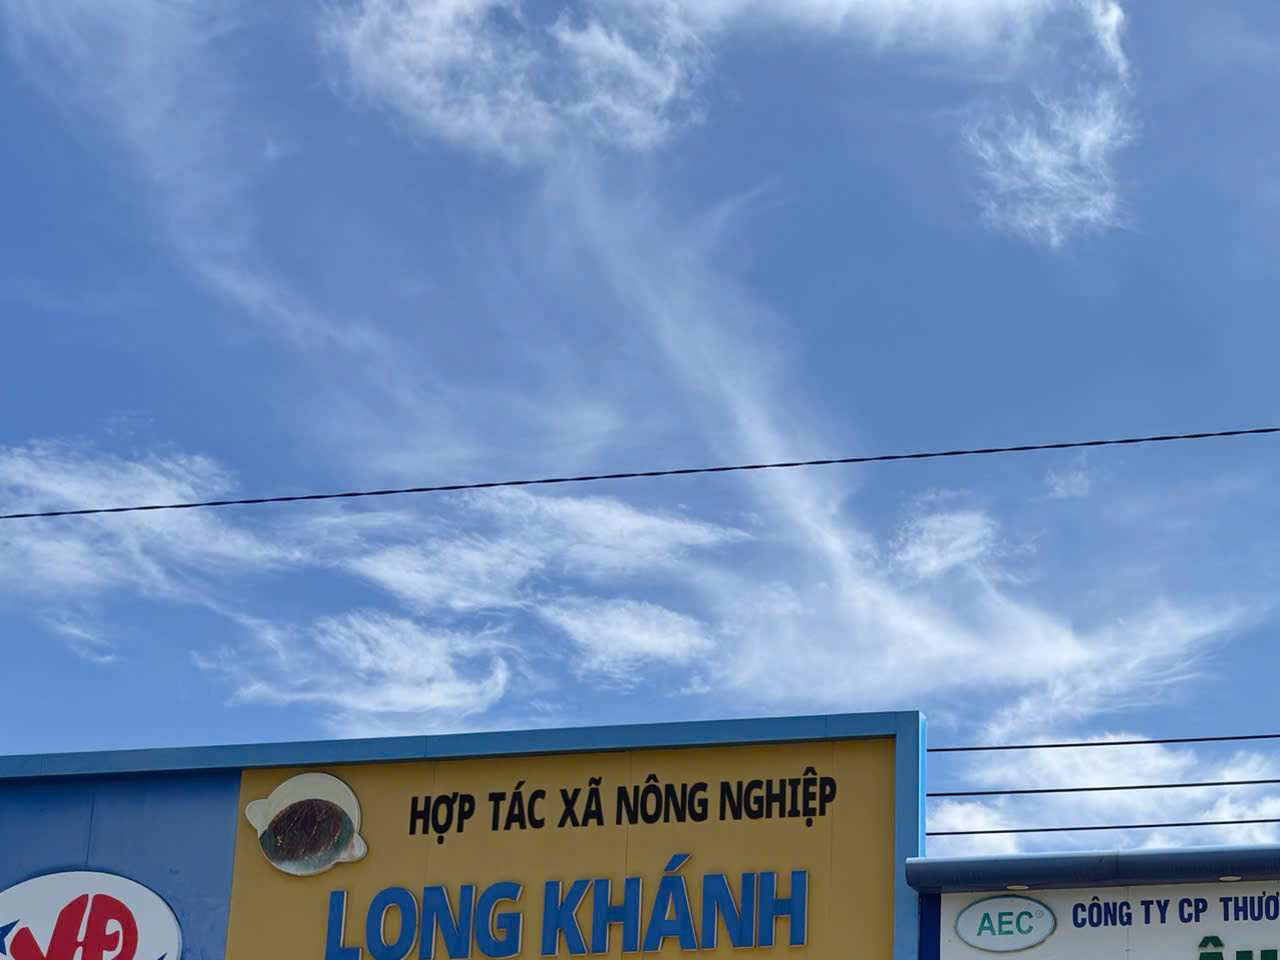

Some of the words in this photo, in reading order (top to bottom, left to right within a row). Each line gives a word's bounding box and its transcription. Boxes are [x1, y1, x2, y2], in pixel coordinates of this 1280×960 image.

[408, 792, 475, 844] HỢP
[488, 781, 545, 832] TÁC
[557, 777, 604, 828] XÃ
[616, 774, 708, 825] NÔNG
[719, 767, 837, 828] NGHIỆP
[541, 853, 809, 957] KHÁNH
[976, 910, 1034, 937] AEC
[1072, 896, 1132, 928] CÔNG
[1141, 898, 1172, 925] TY
[1178, 897, 1208, 923] CP
